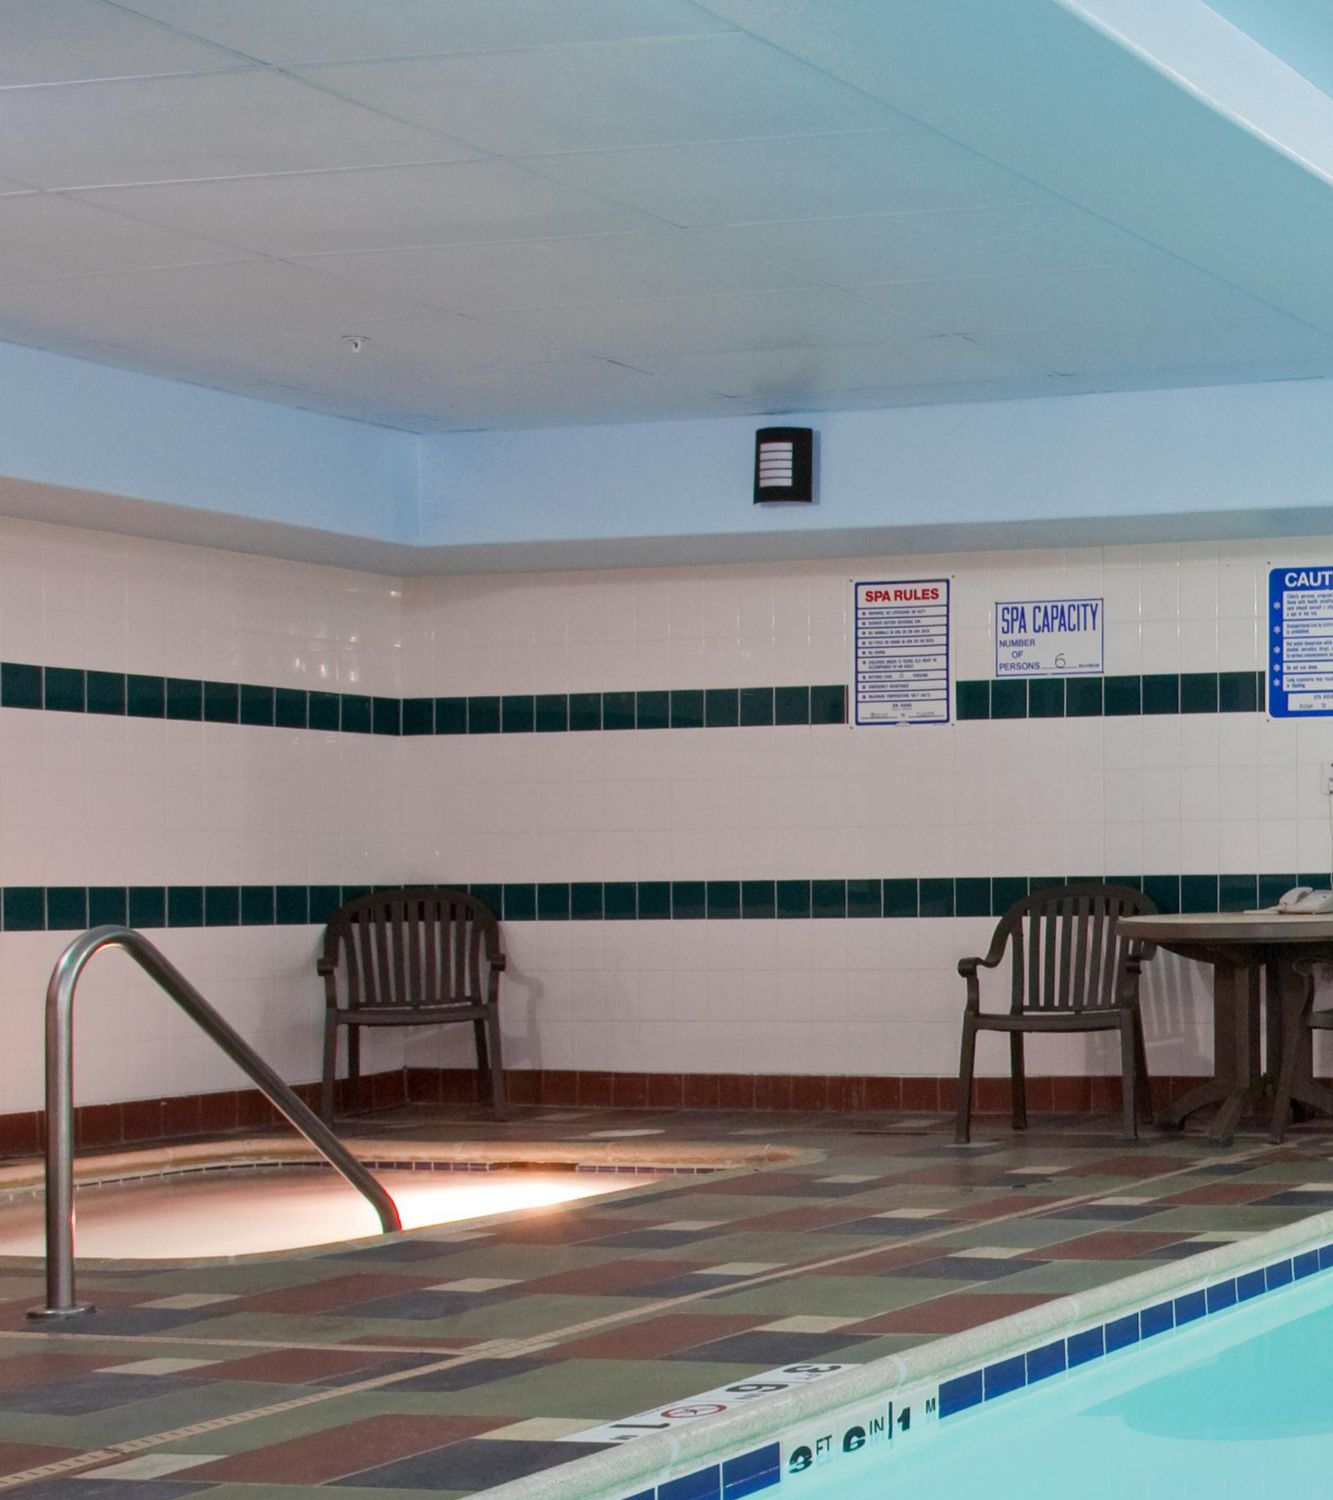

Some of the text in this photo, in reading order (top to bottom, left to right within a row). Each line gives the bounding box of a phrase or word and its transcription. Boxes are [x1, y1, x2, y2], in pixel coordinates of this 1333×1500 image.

[865, 588, 939, 602] SPA RULES
[1001, 603, 1098, 634] SPA CAPACITY
[999, 639, 1036, 648] NUMBER
[1000, 653, 1066, 671] PERSONS 6
[1011, 651, 1024, 659] OF
[816, 1435, 833, 1455] FT
[869, 1416, 884, 1435] IN
[925, 1398, 936, 1414] M
